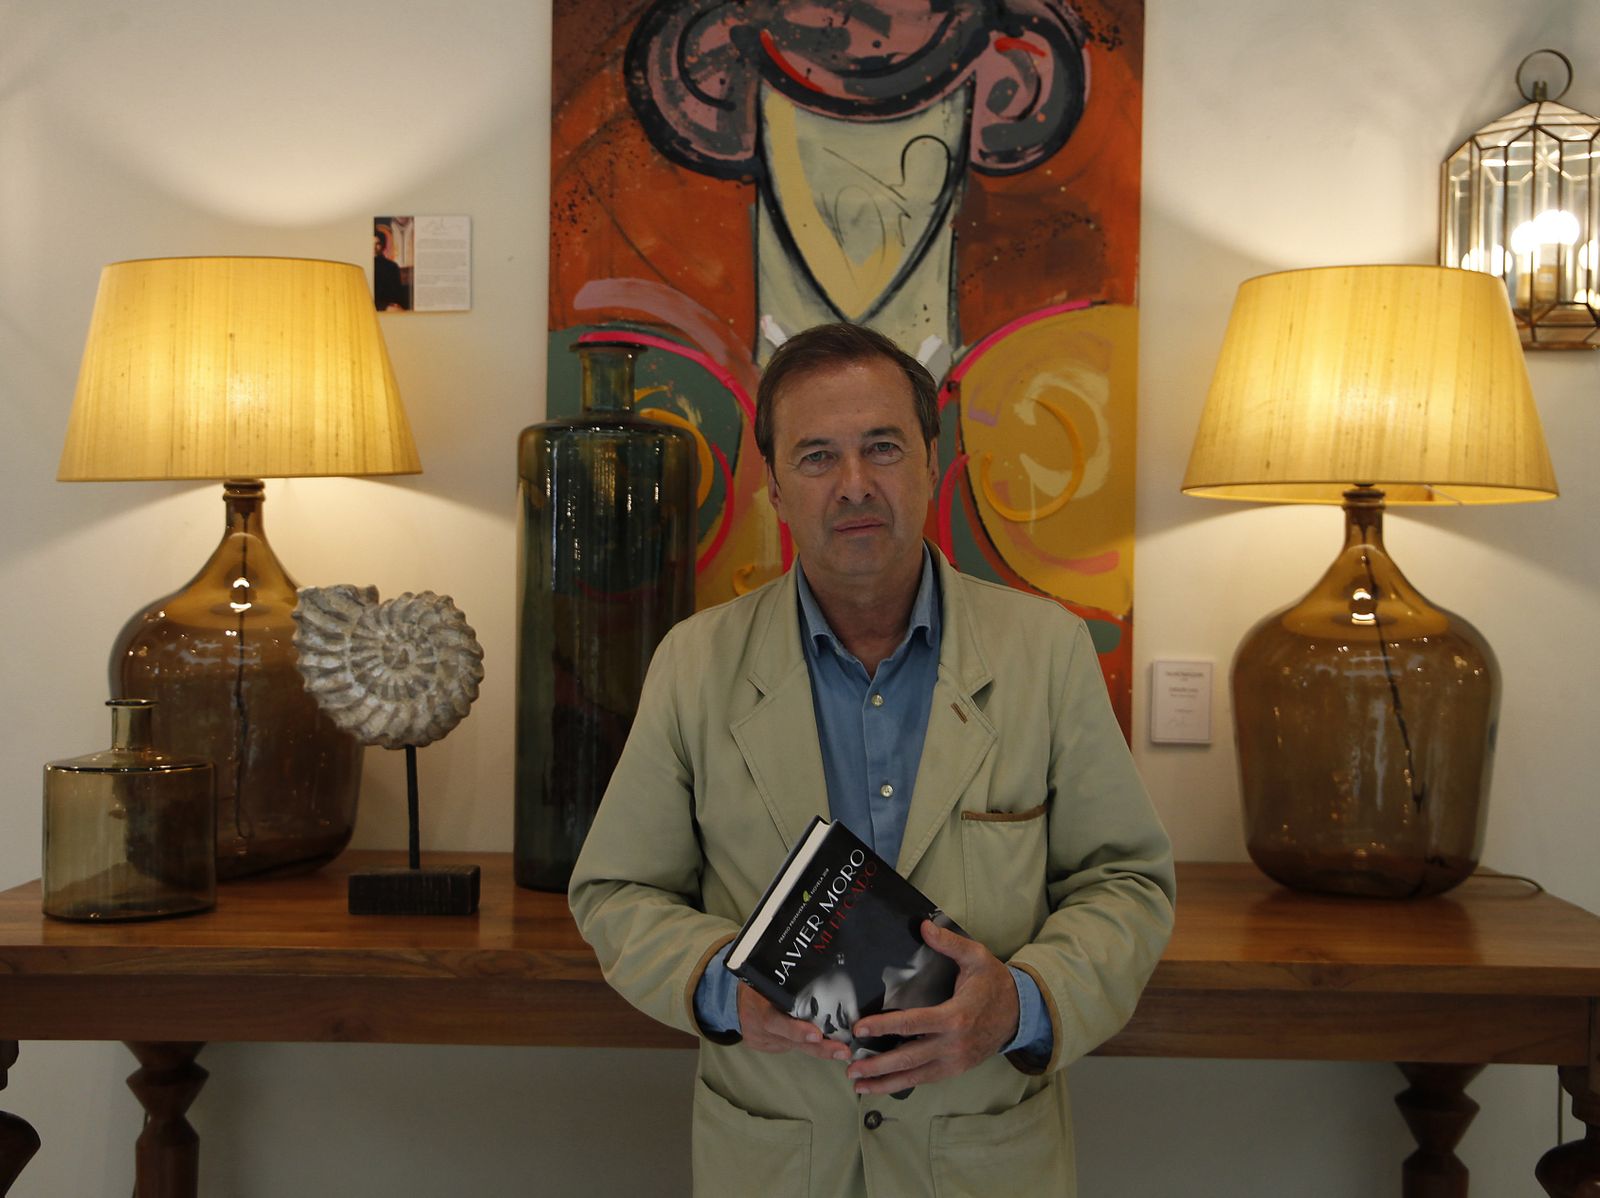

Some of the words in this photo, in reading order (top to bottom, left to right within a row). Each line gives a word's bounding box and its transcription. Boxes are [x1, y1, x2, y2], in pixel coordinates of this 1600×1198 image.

[774, 914, 824, 986] JAVIER
[819, 849, 865, 914] MORO
[811, 876, 824, 895] NOVELA
[811, 929, 833, 955] MI
[828, 861, 877, 930] PECADO
